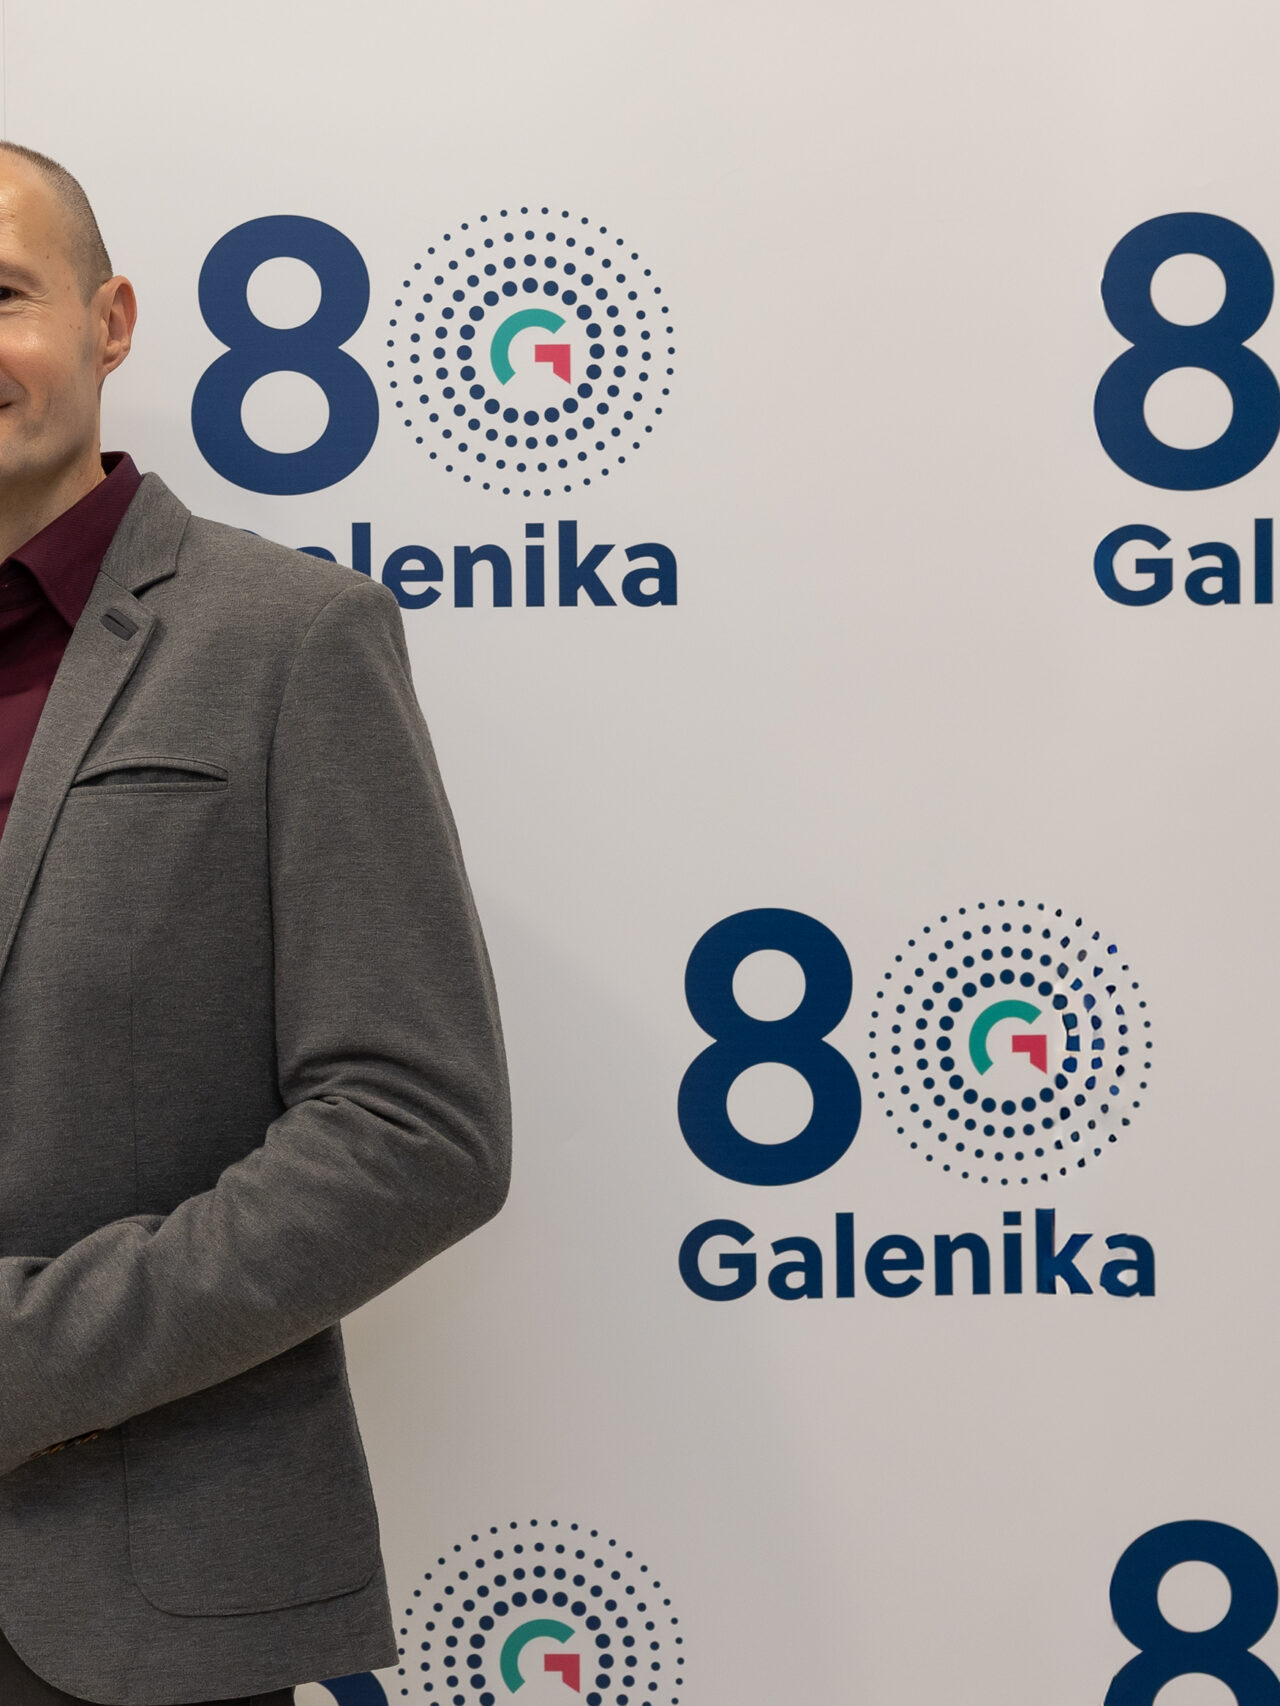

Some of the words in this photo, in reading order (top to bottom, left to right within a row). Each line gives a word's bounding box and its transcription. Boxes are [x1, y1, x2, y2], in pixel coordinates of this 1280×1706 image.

[239, 519, 678, 610] lenika
[1093, 518, 1273, 607] Gal
[679, 1208, 1156, 1302] Galenika
